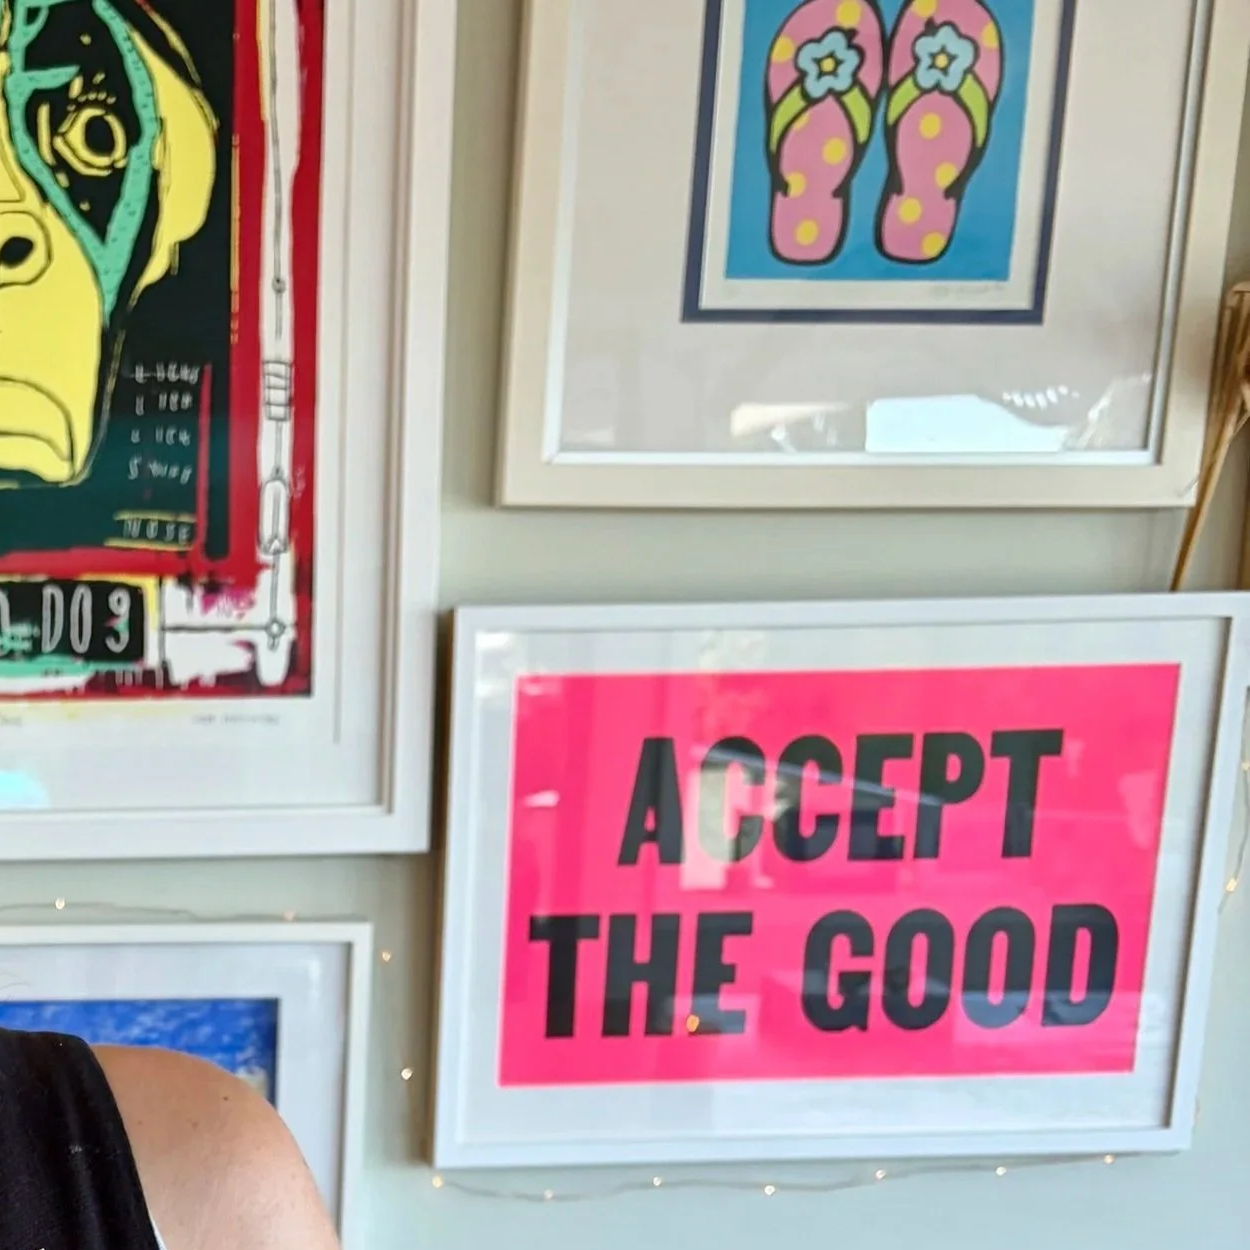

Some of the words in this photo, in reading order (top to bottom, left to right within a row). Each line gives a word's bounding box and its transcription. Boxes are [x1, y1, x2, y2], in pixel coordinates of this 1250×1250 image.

[617, 729, 1064, 866] ACCEPT
[529, 912, 753, 1038] THE
[800, 903, 1121, 1034] GOOD
